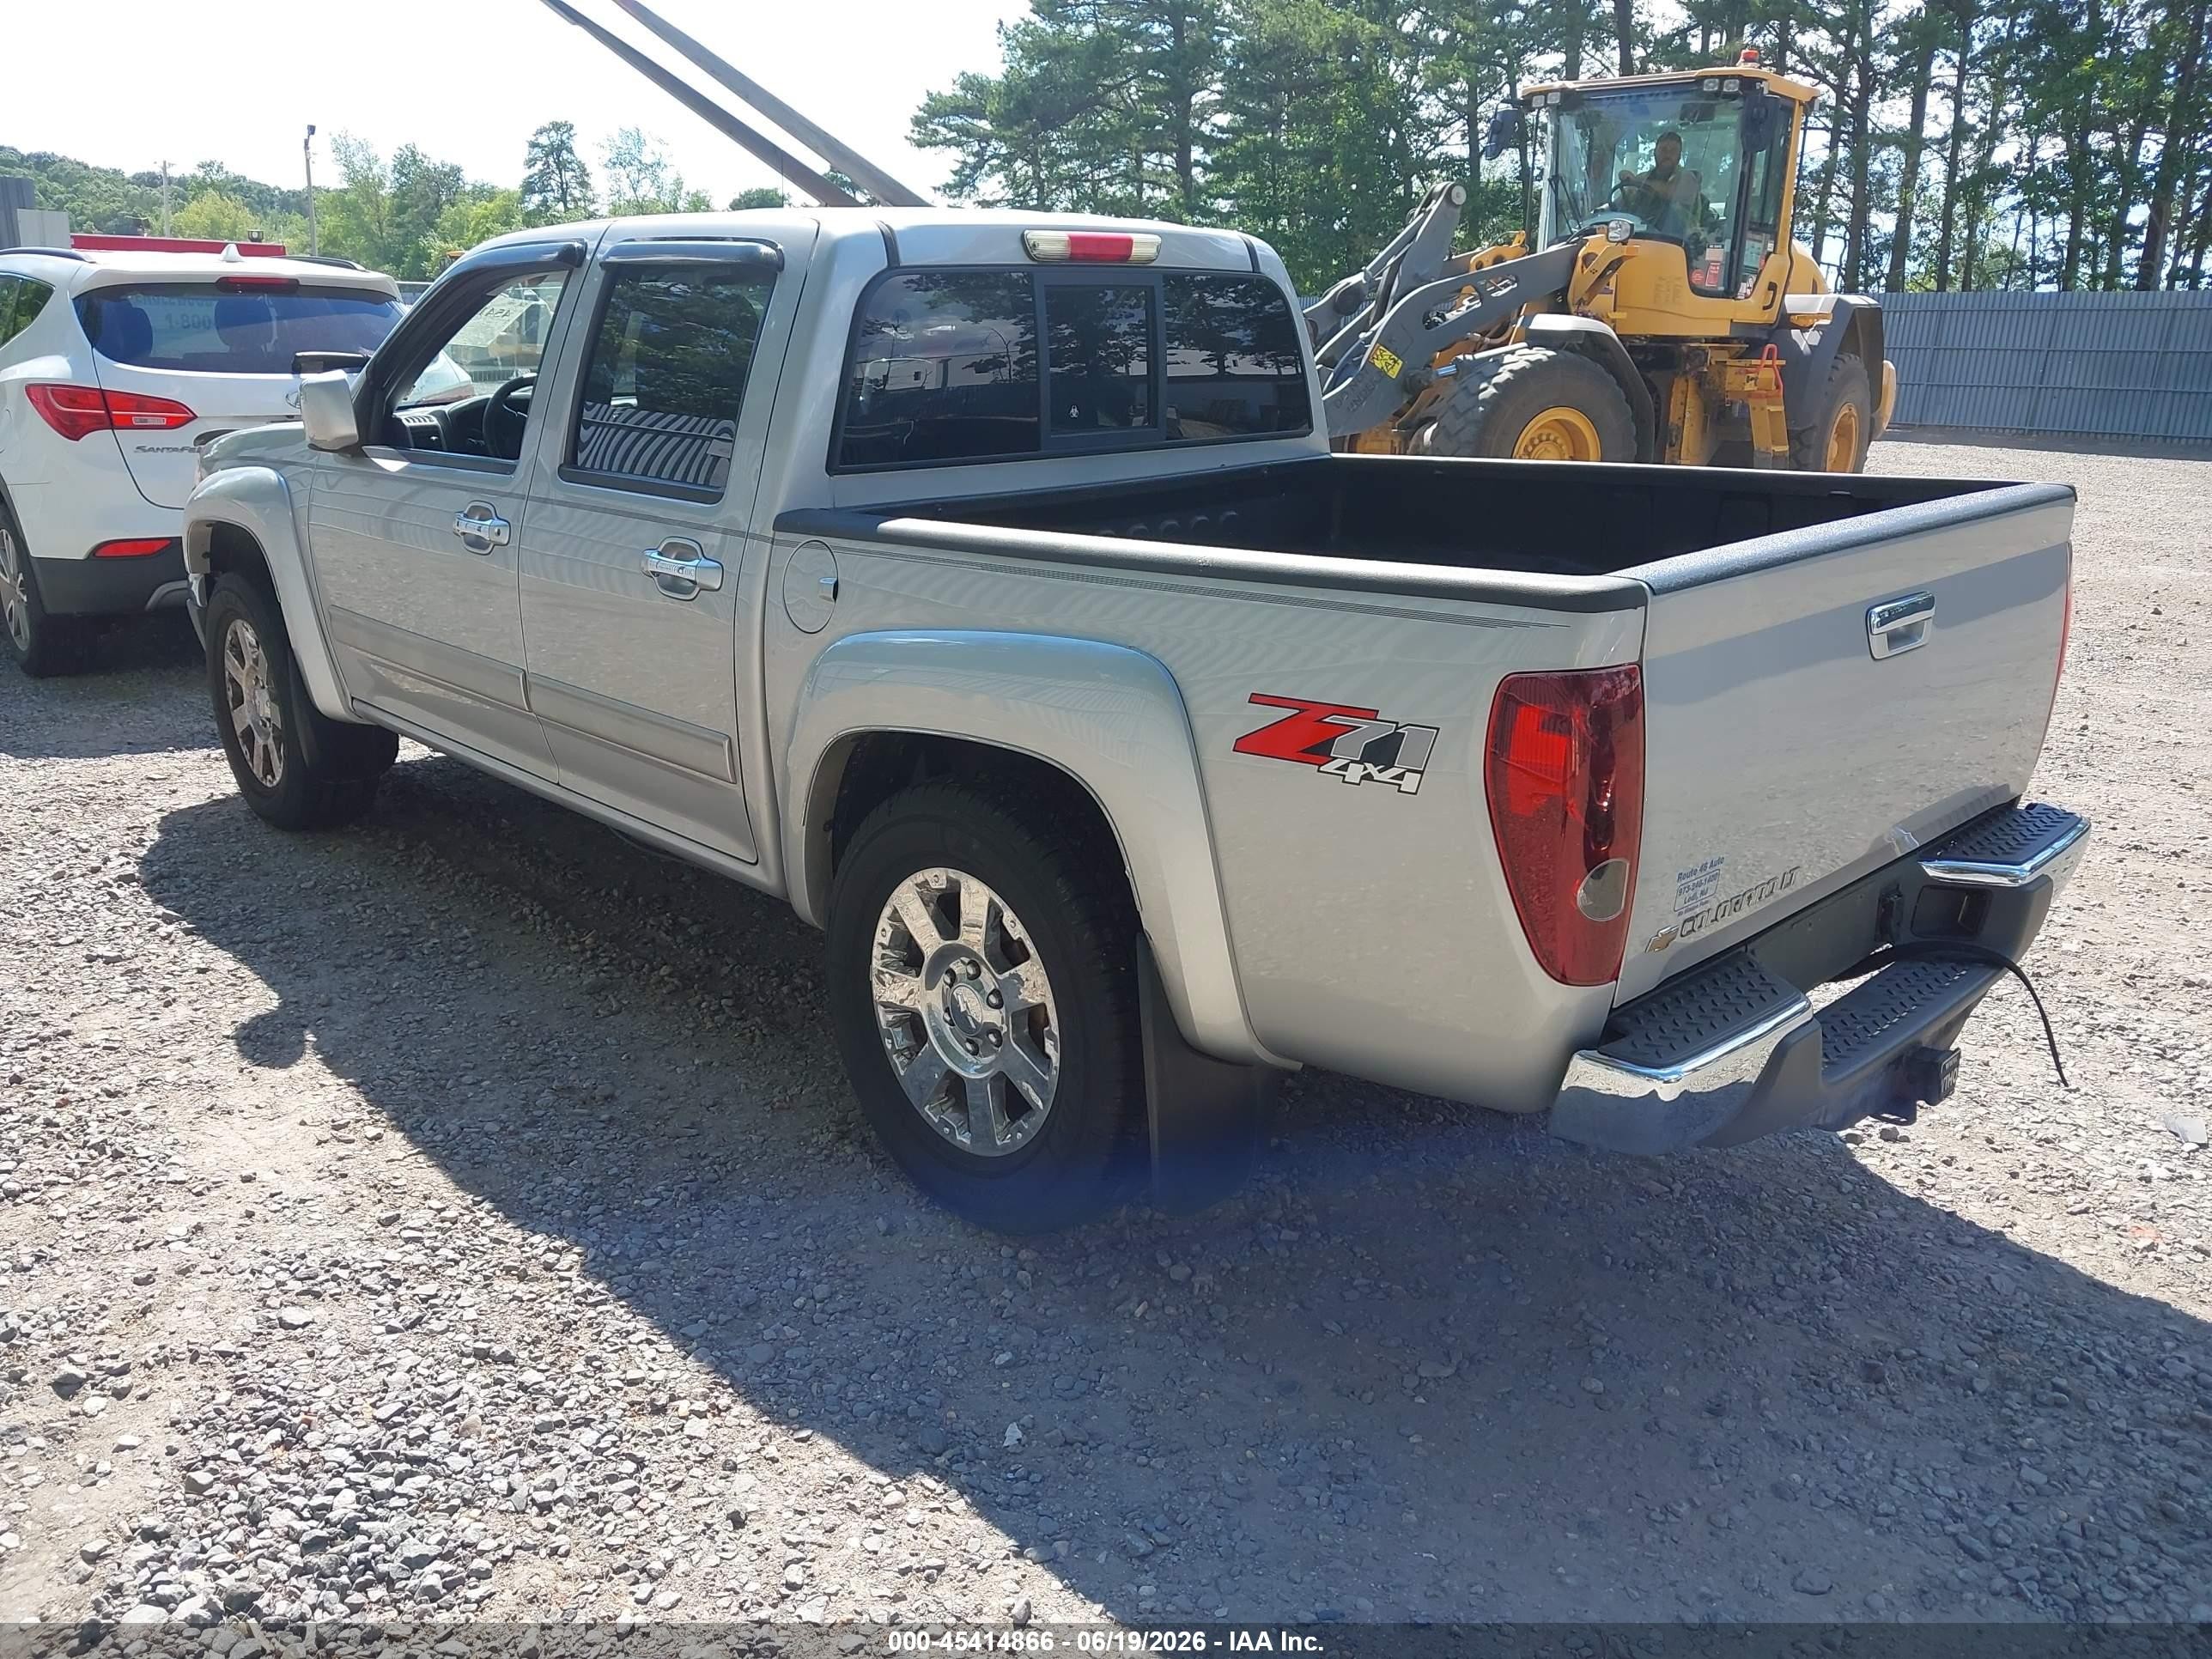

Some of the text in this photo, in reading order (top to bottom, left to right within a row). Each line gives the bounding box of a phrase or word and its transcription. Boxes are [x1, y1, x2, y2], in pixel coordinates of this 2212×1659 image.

[1233, 693, 1440, 772] Z71
[1677, 867, 1698, 883] Route
[1709, 856, 1725, 869] Auto
[1680, 877, 1778, 938] COLORADO
[1779, 866, 1800, 890] LT
